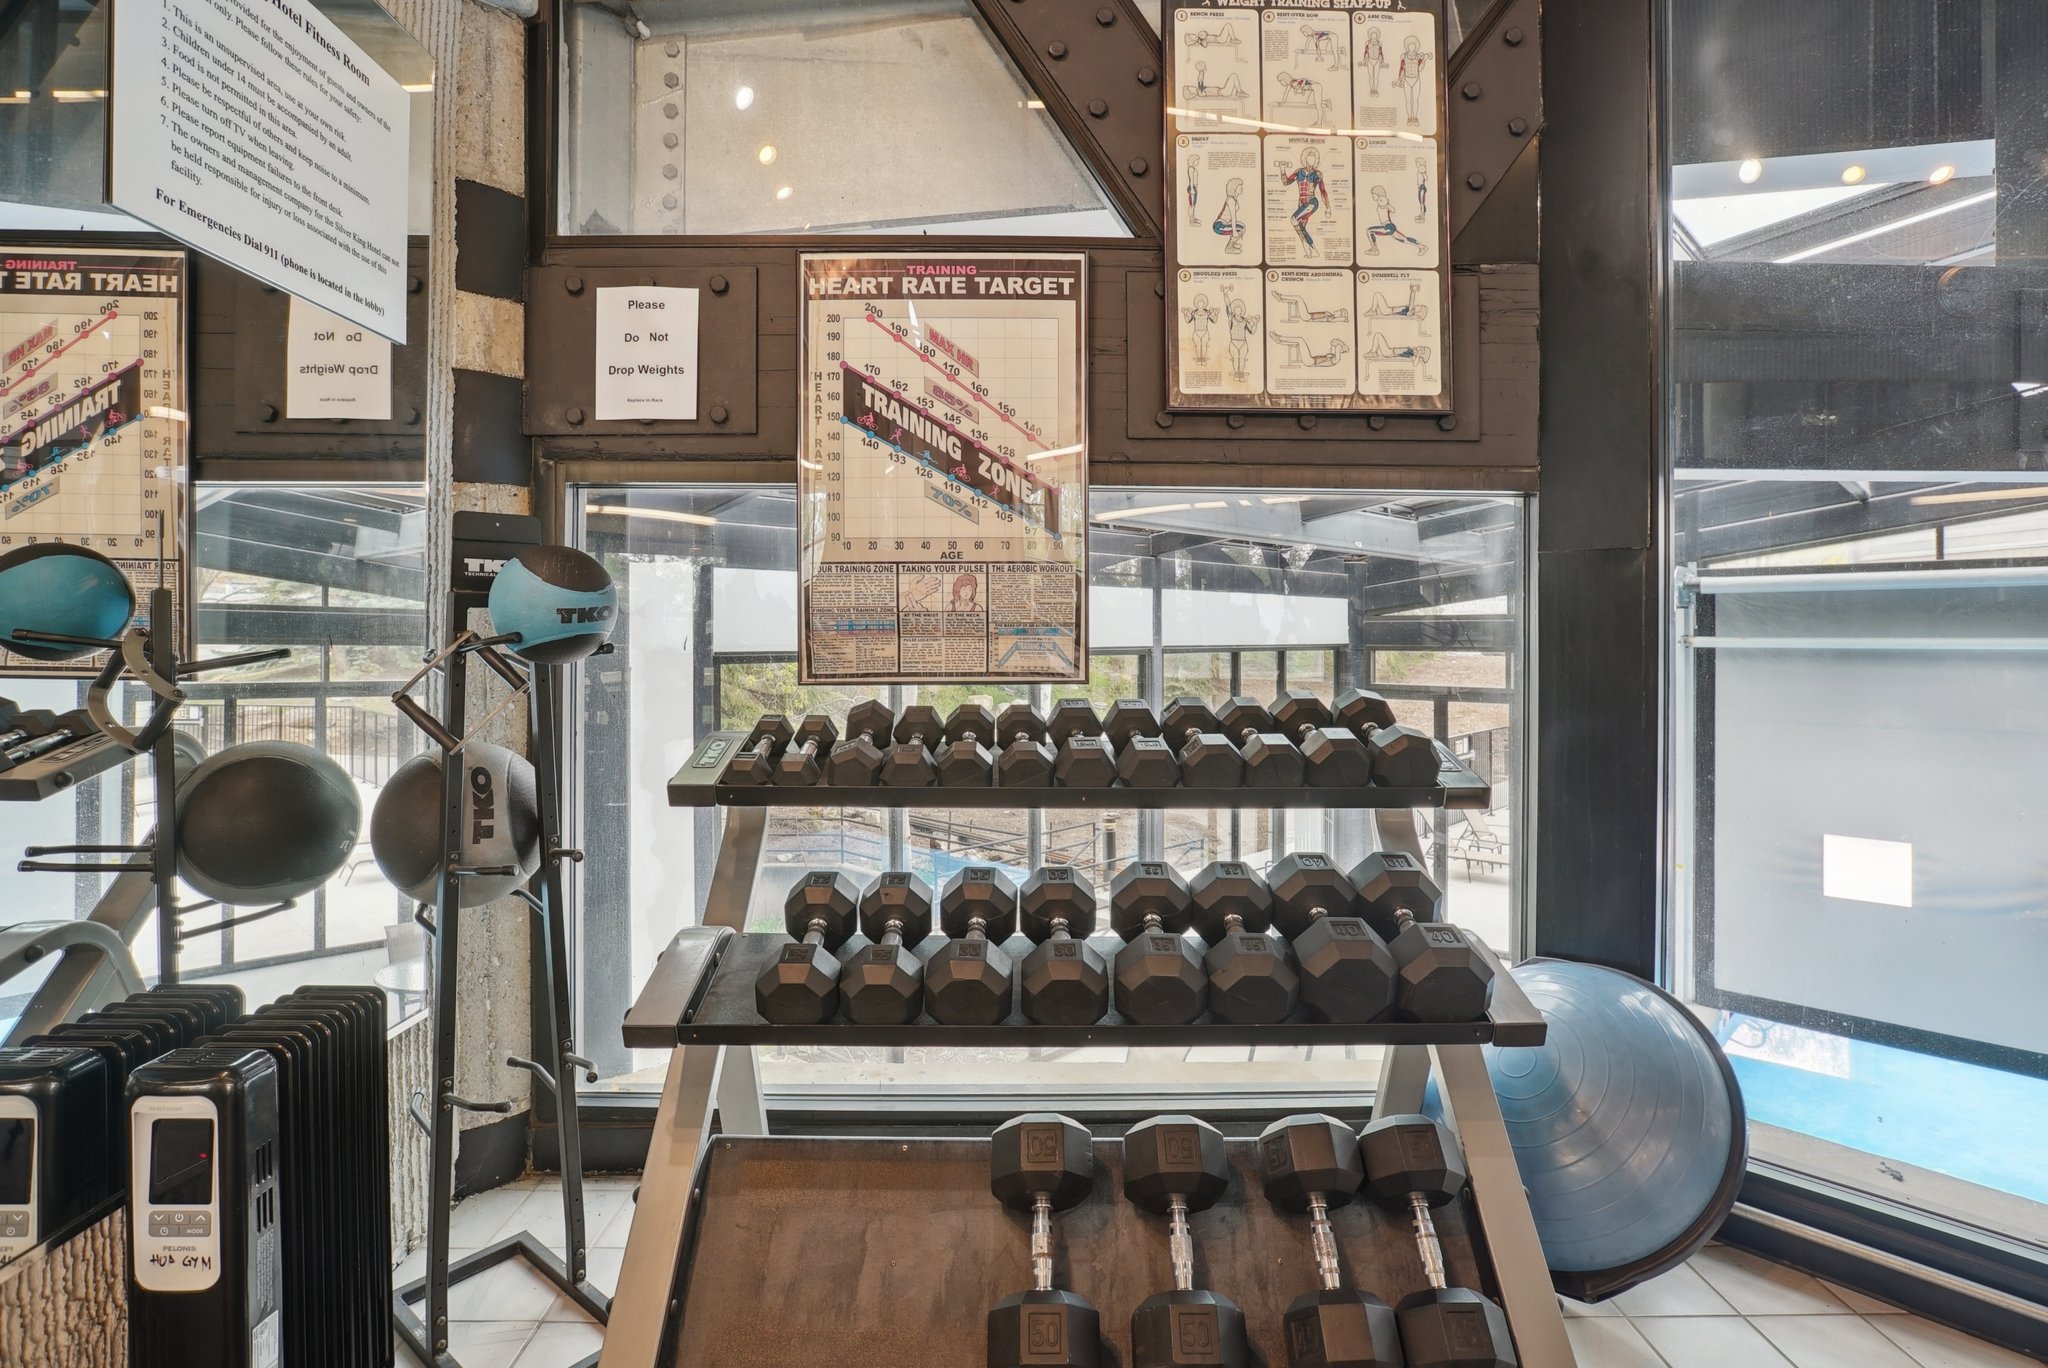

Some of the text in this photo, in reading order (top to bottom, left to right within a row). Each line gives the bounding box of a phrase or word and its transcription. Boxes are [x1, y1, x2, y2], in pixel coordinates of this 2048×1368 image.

[271, 0, 370, 87] Hotel Fitness Room
[172, 5, 192, 27] This
[195, 21, 201, 34] is
[203, 32, 213, 43] an
[215, 40, 264, 81] unsupervised
[266, 78, 282, 96] area,
[284, 92, 295, 104] use
[304, 106, 318, 121] your
[319, 119, 333, 132] own
[333, 128, 346, 142] risk.
[161, 36, 297, 139] 3. Food is not permitted in this area.
[161, 17, 169, 30] 2.
[173, 26, 209, 59] Children
[211, 56, 234, 76] under
[237, 72, 245, 84] 14
[247, 82, 265, 99] must
[266, 93, 275, 106] be
[276, 103, 318, 137] accompanied
[336, 147, 352, 162] adult.
[160, 76, 294, 171] 5. Please turn off TV when leaving.
[170, 160, 202, 185] facility.
[155, 187, 175, 207] For
[178, 200, 241, 241] Emergencies
[243, 233, 261, 252] Dial
[264, 245, 278, 260] 911
[280, 254, 307, 275] (phone
[317, 273, 342, 293] located
[353, 293, 363, 304] the
[364, 298, 384, 317] lobby)
[906, 265, 977, 275] TRAINING
[808, 277, 1075, 296] HEART RATE TARGET
[628, 300, 666, 310] Please
[864, 302, 883, 318] 200
[826, 314, 841, 323] 200
[826, 332, 841, 341] 190
[890, 322, 908, 338] 190
[624, 332, 669, 342] Do Not
[826, 352, 841, 361] 180
[918, 342, 936, 358] 180
[928, 328, 975, 372] MAX HR
[608, 365, 684, 376] Drop Weights
[864, 363, 881, 376] 170
[942, 362, 960, 376] 170
[826, 372, 841, 381] 170
[890, 380, 908, 392] 162
[970, 382, 988, 397] 160
[826, 392, 841, 401] 160
[916, 397, 935, 409] 153
[932, 384, 973, 418] 85%
[997, 402, 1016, 417] 150
[826, 412, 841, 421] 150
[943, 412, 962, 426] 145
[826, 432, 841, 441] 140
[970, 429, 989, 441] 136
[860, 437, 879, 450] 140
[862, 382, 1034, 502] TRAINING ZONE
[826, 452, 841, 462] 130
[996, 445, 1015, 458] 128
[888, 452, 906, 465] 133
[826, 472, 841, 482] 120
[915, 466, 933, 479] 126
[943, 481, 961, 494] 119
[826, 492, 841, 502] 110
[930, 486, 973, 519] 70%
[970, 496, 988, 509] 112
[826, 512, 841, 522] 100
[995, 510, 1014, 524] 105
[830, 532, 841, 542] 90
[842, 541, 1064, 551] 10 20 30 40 50 60 70 80 90
[940, 551, 964, 560] AGE
[464, 558, 507, 572] TK
[835, 565, 894, 573] TRAINING ZONE
[902, 565, 984, 573] TAKING YOUR PULSE
[992, 565, 1074, 573] THE AEROBIC WORKOUT
[556, 606, 612, 624] TKO
[700, 741, 726, 764] TKO
[471, 767, 494, 844] TKO
[1031, 1136, 1056, 1157] 50
[1167, 1138, 1192, 1159] 50
[182, 1255, 212, 1272] GYM
[1032, 1321, 1058, 1347] 50
[1184, 1322, 1209, 1347] 50
